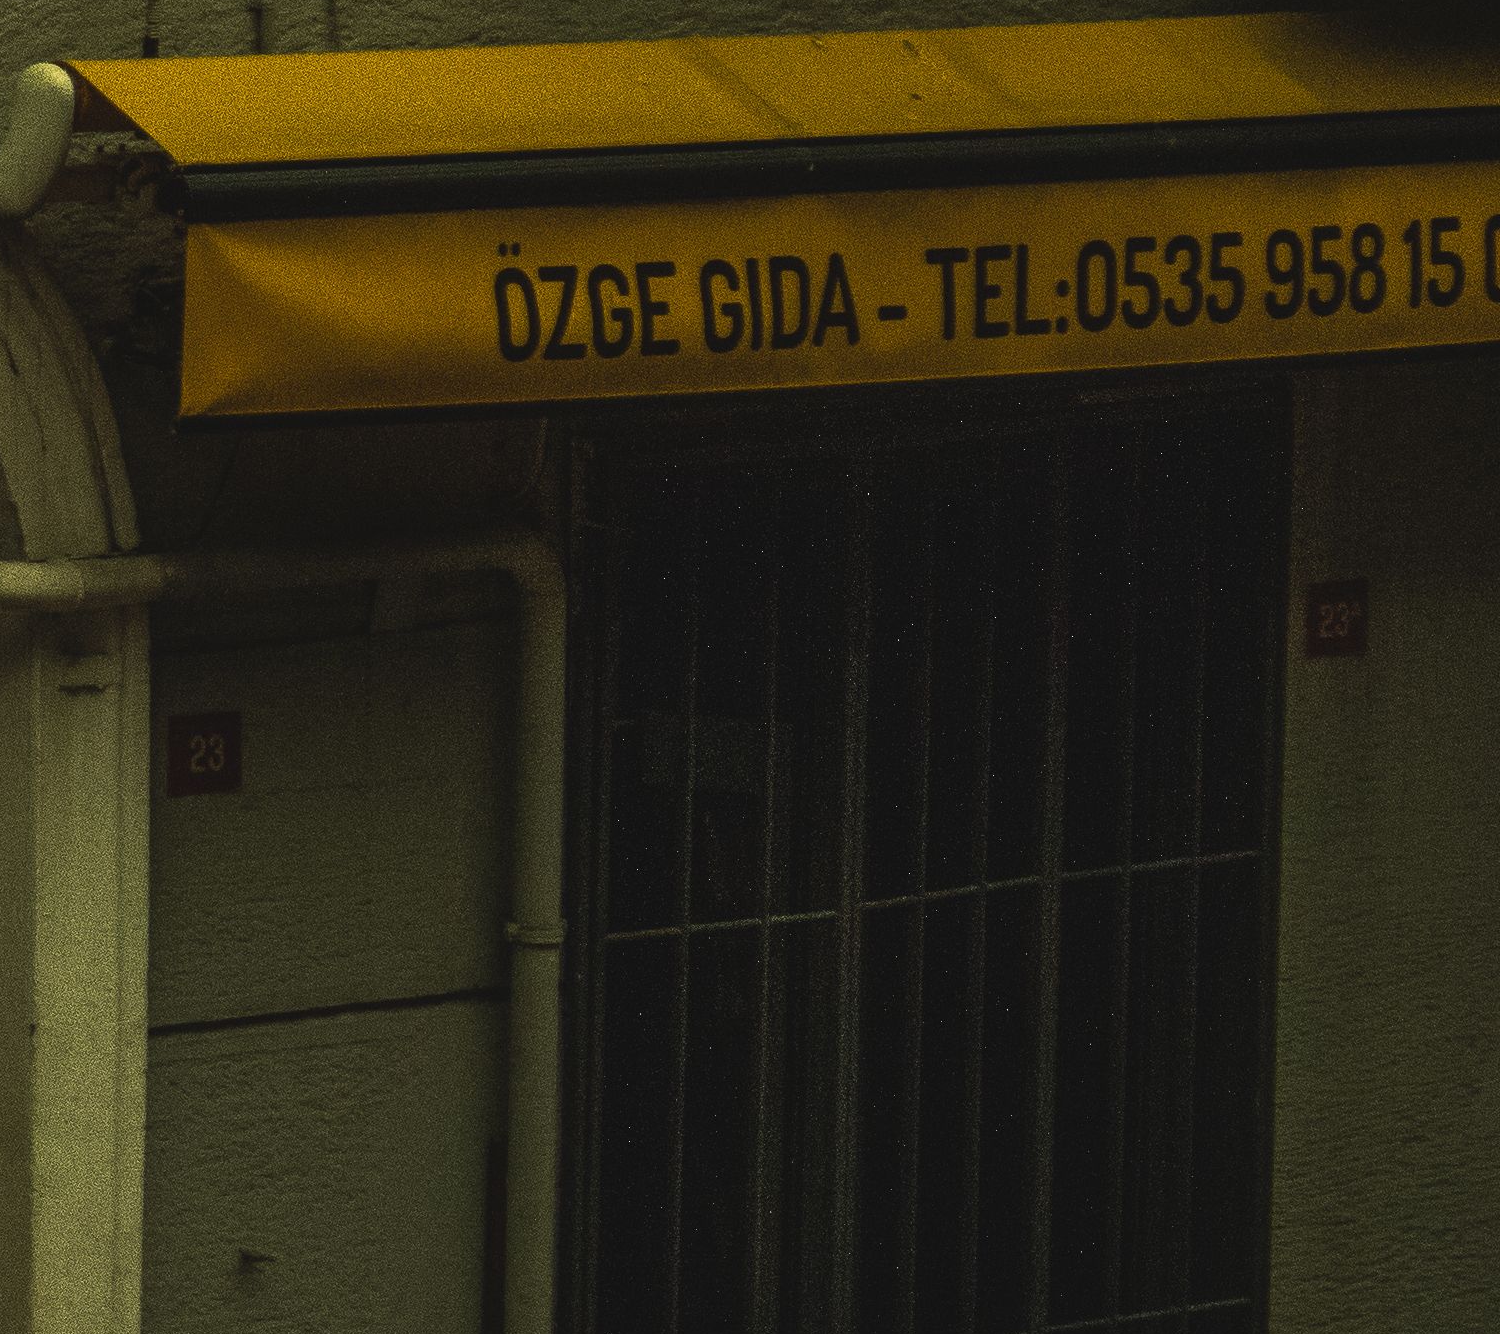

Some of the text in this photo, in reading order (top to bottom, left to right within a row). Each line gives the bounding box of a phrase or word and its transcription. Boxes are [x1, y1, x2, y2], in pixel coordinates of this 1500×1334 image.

[494, 243, 680, 363] ÖZGE
[699, 252, 861, 354] GIDA
[1265, 222, 1387, 318] 958
[1404, 217, 1465, 308] 15
[189, 735, 225, 773] 23
